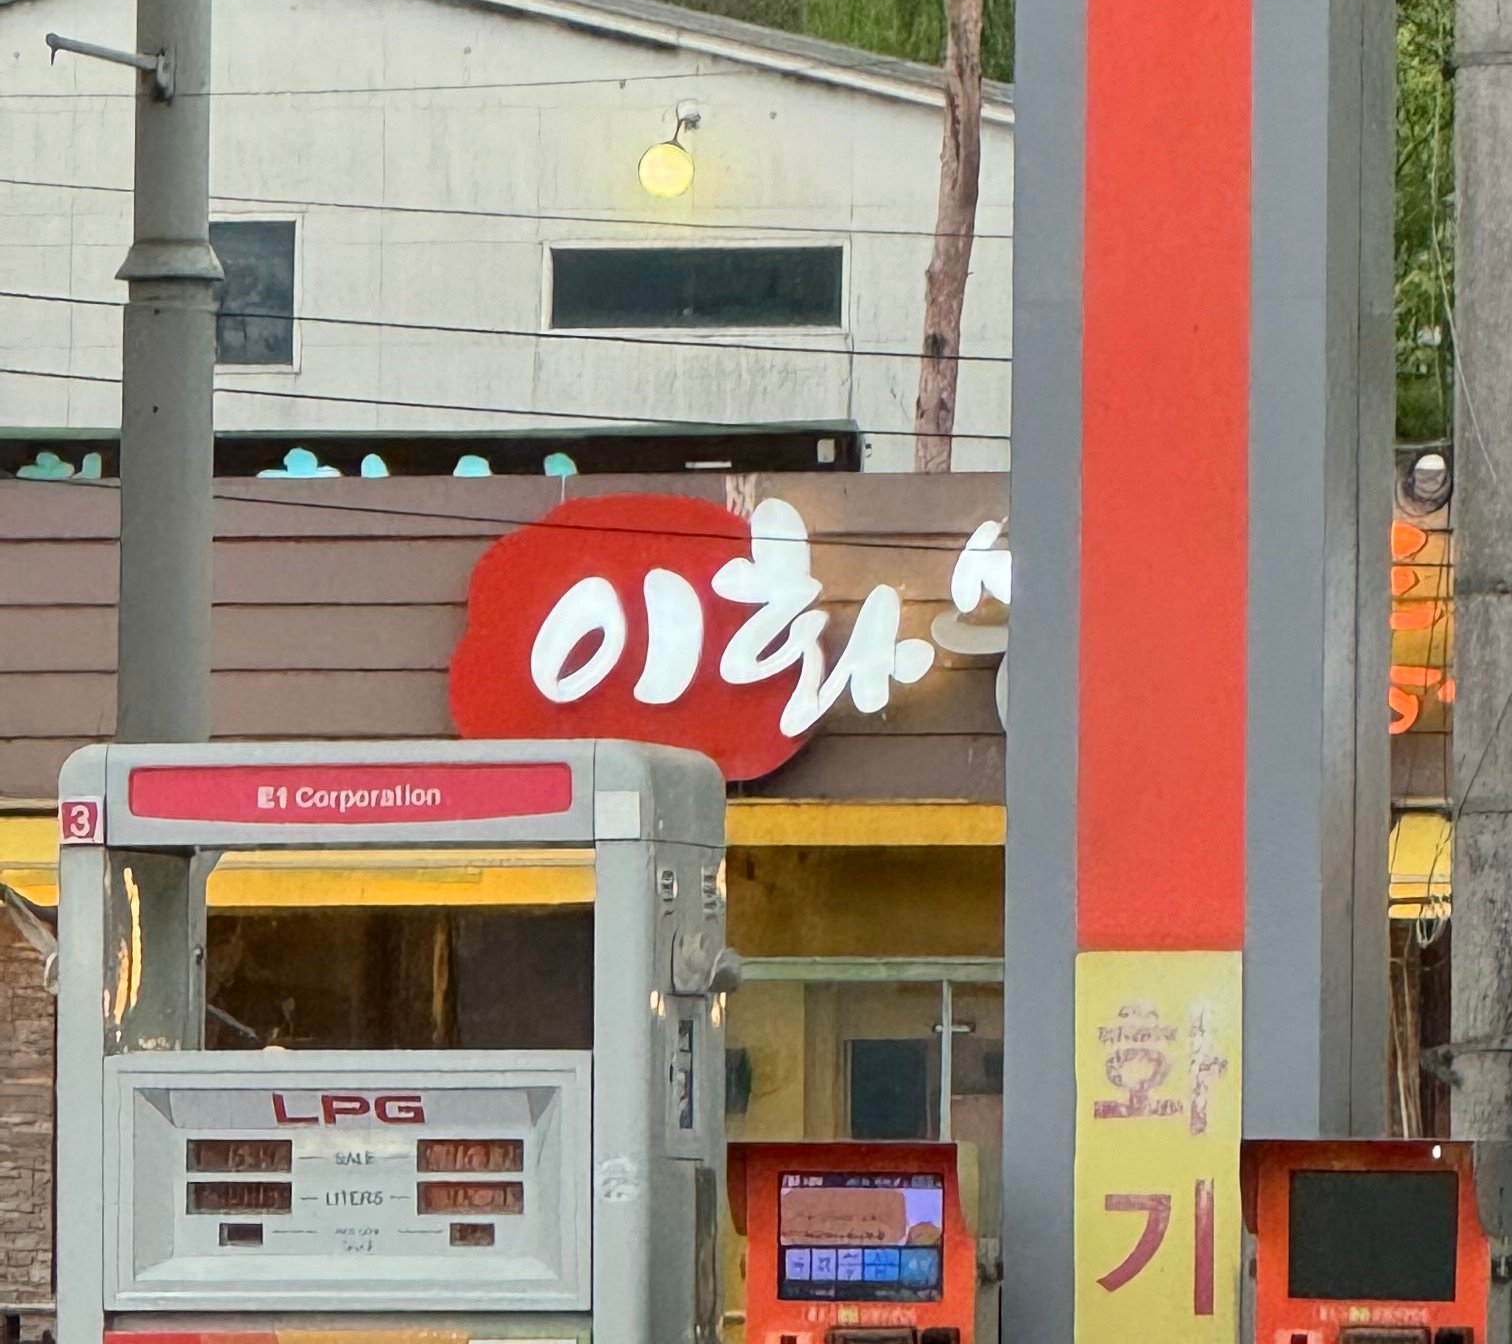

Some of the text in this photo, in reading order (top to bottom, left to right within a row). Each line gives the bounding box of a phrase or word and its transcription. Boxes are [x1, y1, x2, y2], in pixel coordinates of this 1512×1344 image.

[257, 784, 441, 813] E1 Corporation
[69, 805, 91, 837] 3
[272, 1092, 426, 1126] LPG
